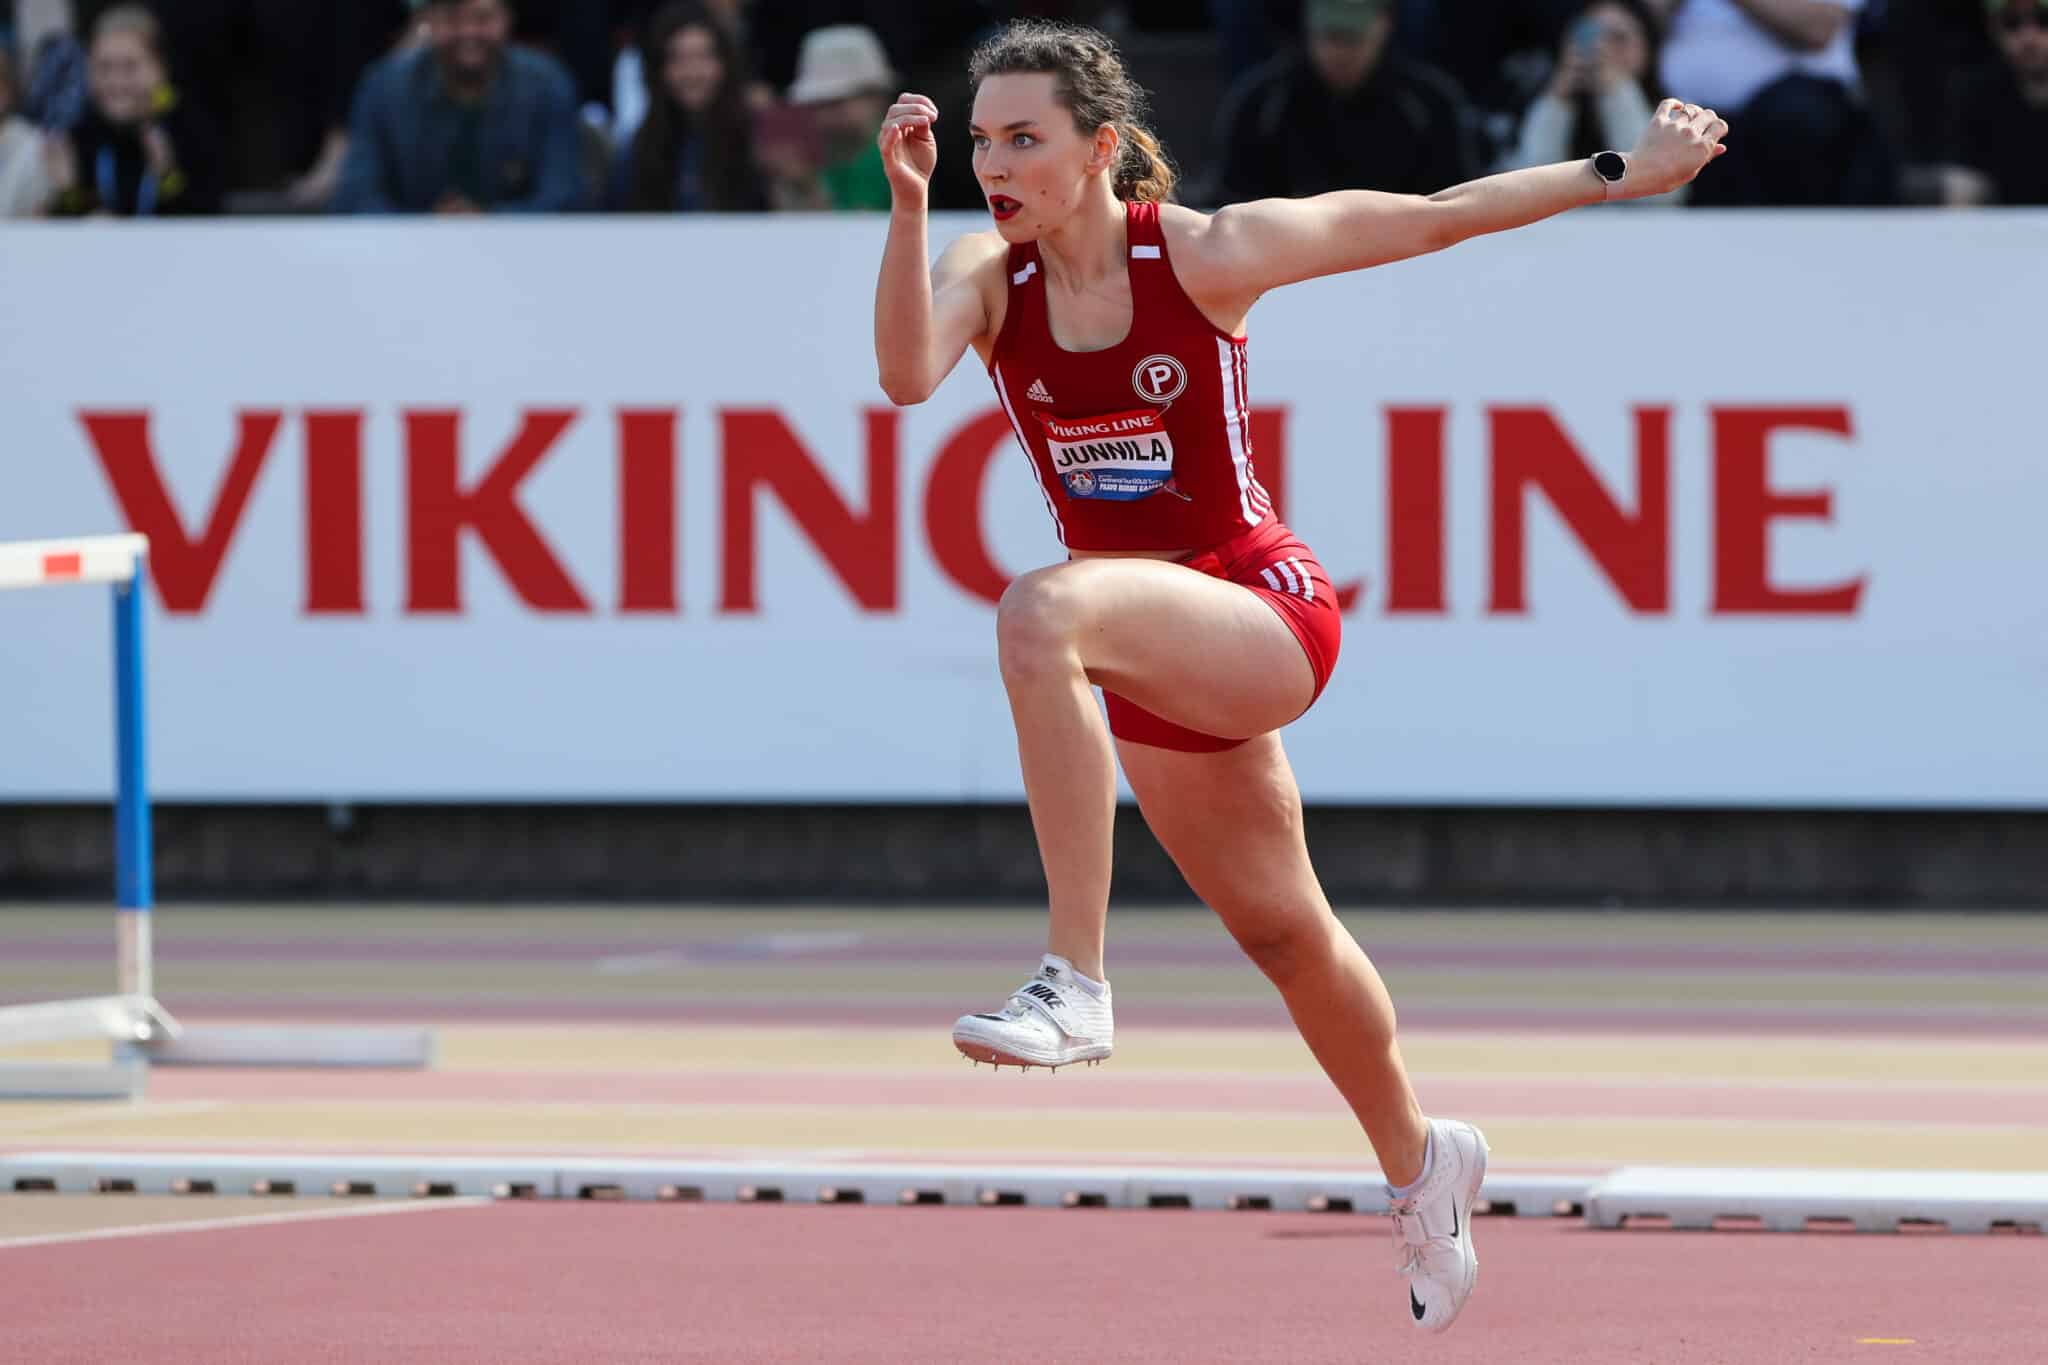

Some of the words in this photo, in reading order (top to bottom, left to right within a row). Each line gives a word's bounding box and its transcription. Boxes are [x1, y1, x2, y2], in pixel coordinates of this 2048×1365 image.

[1148, 364, 1172, 394] P
[1048, 421, 1110, 437] VIKING
[1112, 415, 1154, 431] LINE
[1057, 438, 1168, 467] JUNNILA
[1023, 983, 1067, 1010] NIKE
